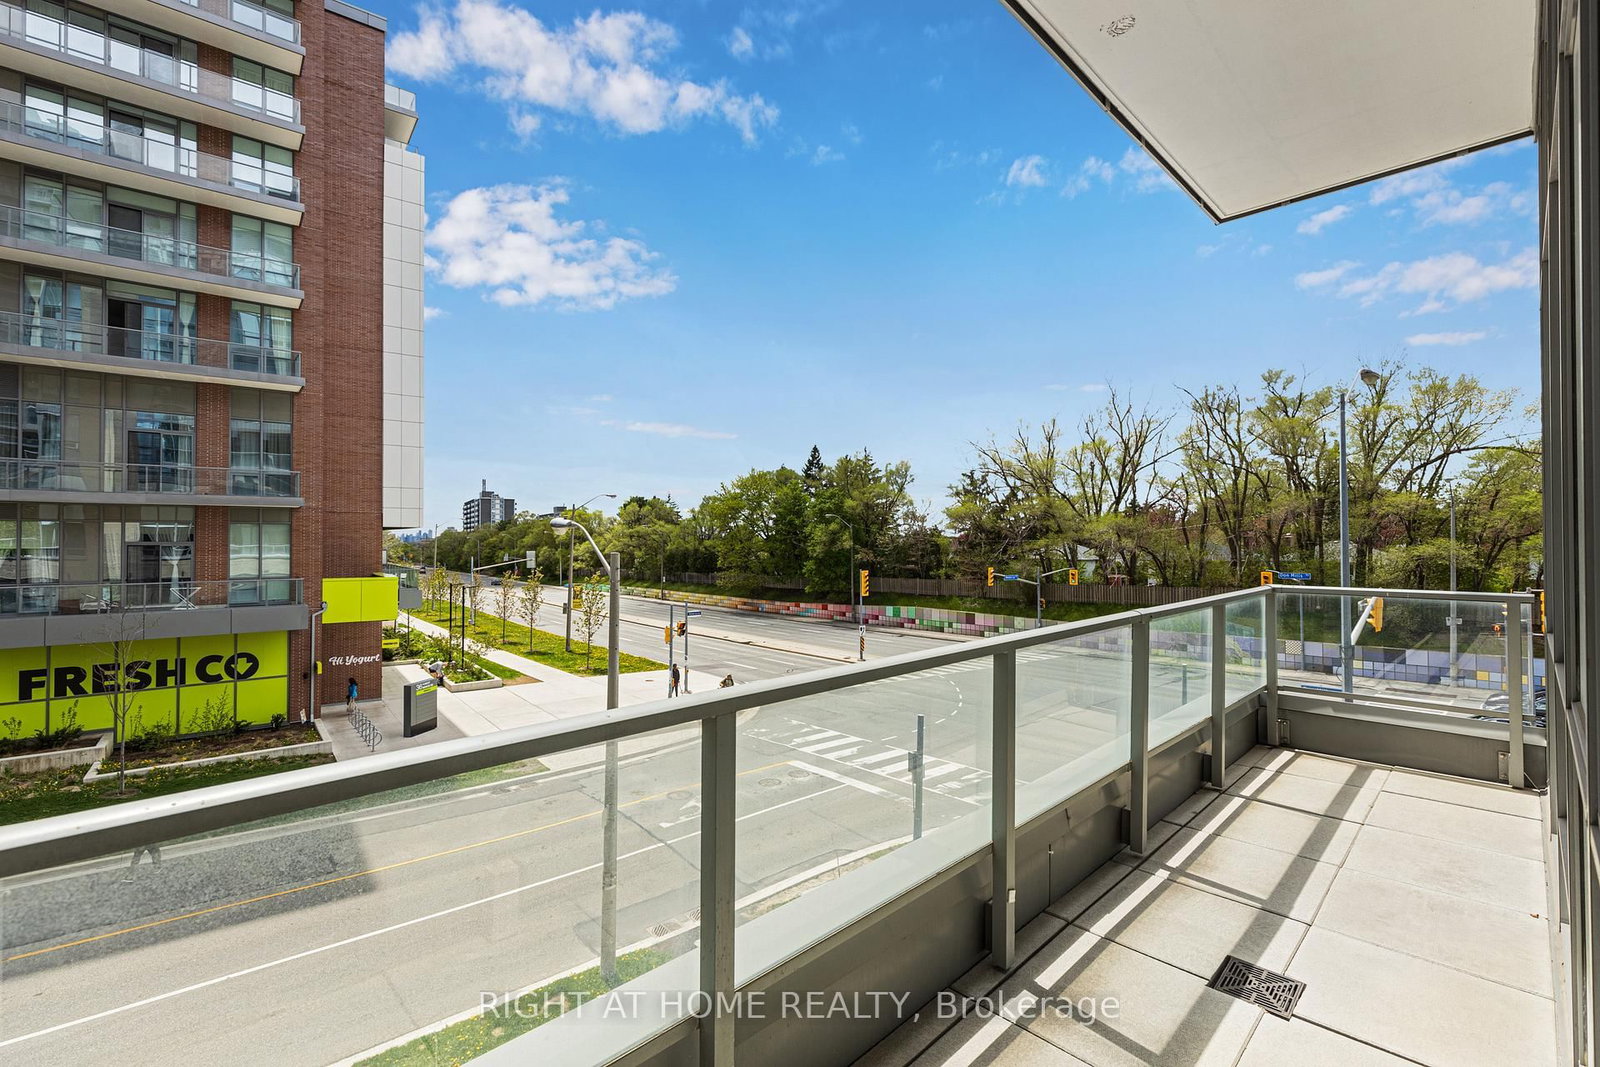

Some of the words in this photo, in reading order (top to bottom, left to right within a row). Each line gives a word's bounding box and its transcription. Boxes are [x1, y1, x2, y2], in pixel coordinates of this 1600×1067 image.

[329, 656, 345, 666] Hi
[345, 653, 380, 666] Yogurt
[18, 657, 186, 701] FRESH
